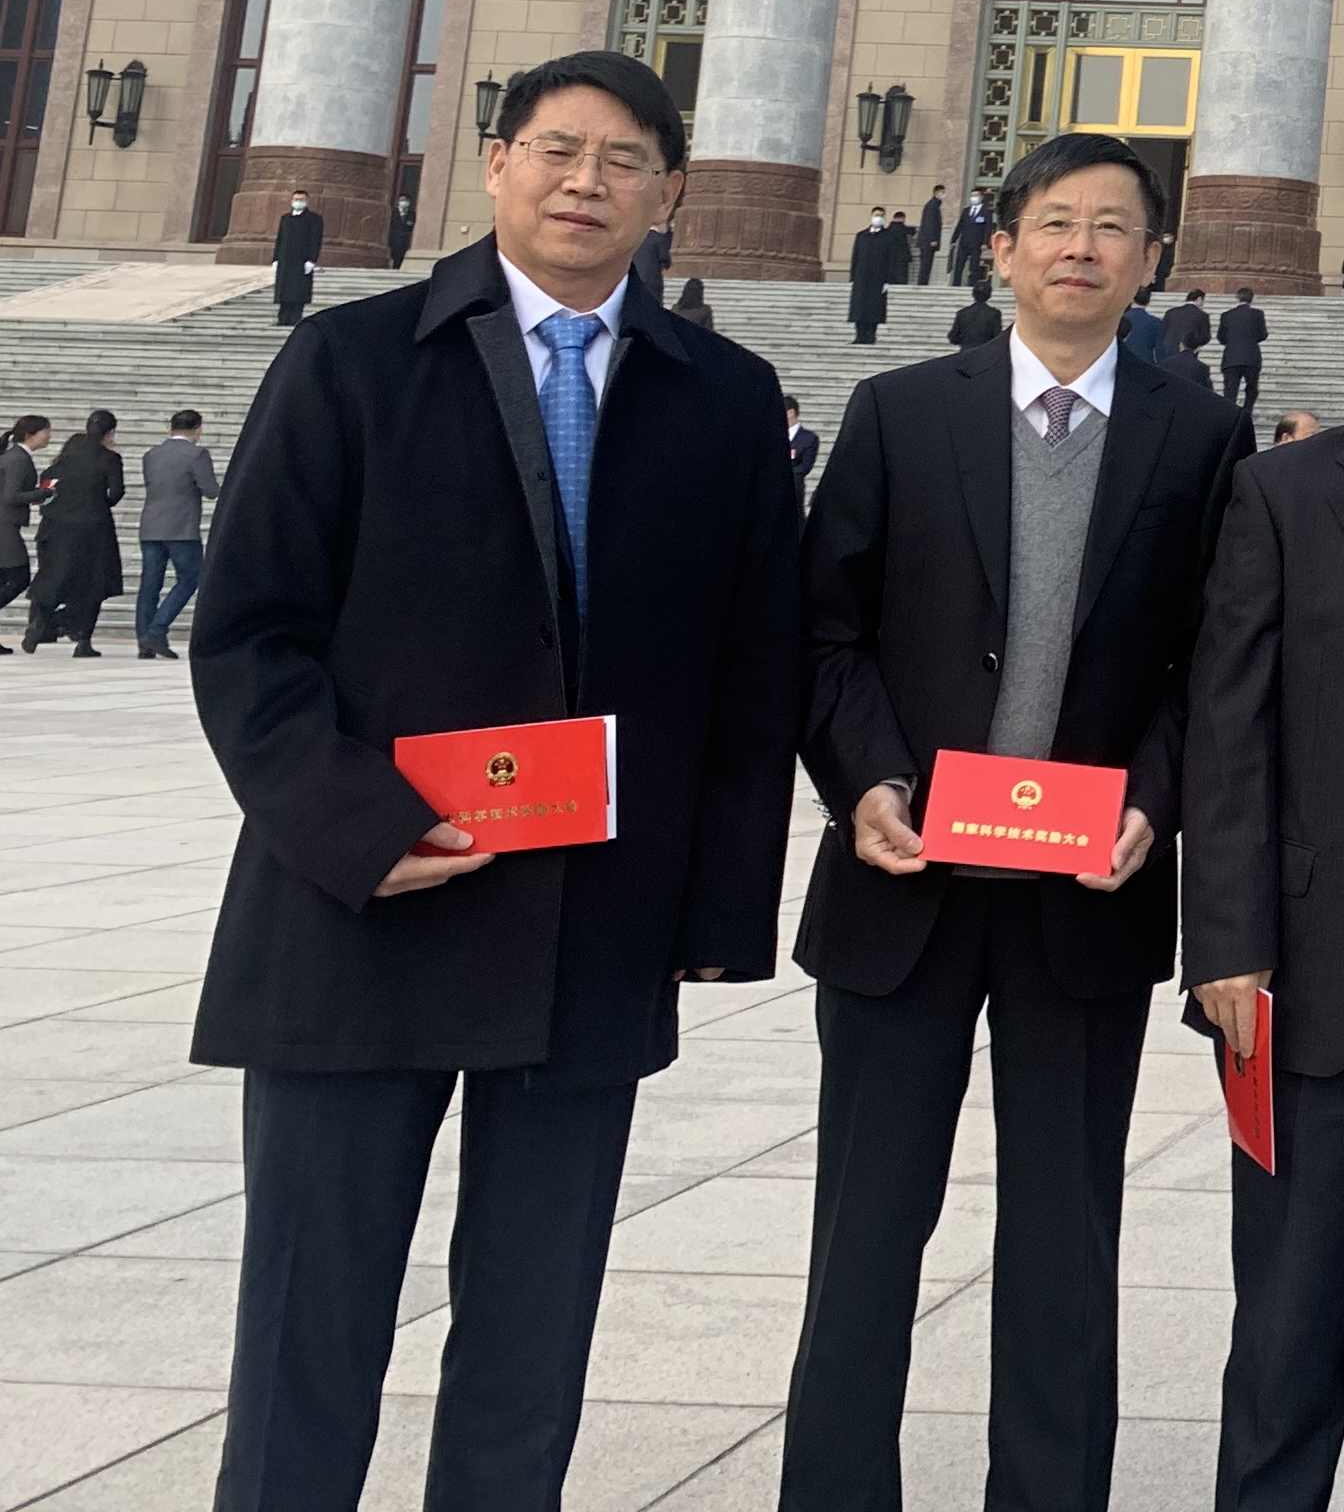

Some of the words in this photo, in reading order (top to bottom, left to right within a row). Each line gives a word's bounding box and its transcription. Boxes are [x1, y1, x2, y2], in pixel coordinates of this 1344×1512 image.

[443, 799, 578, 824] 家科学技术奖励大会
[951, 821, 1090, 847] 国家科学技术奖励大会
